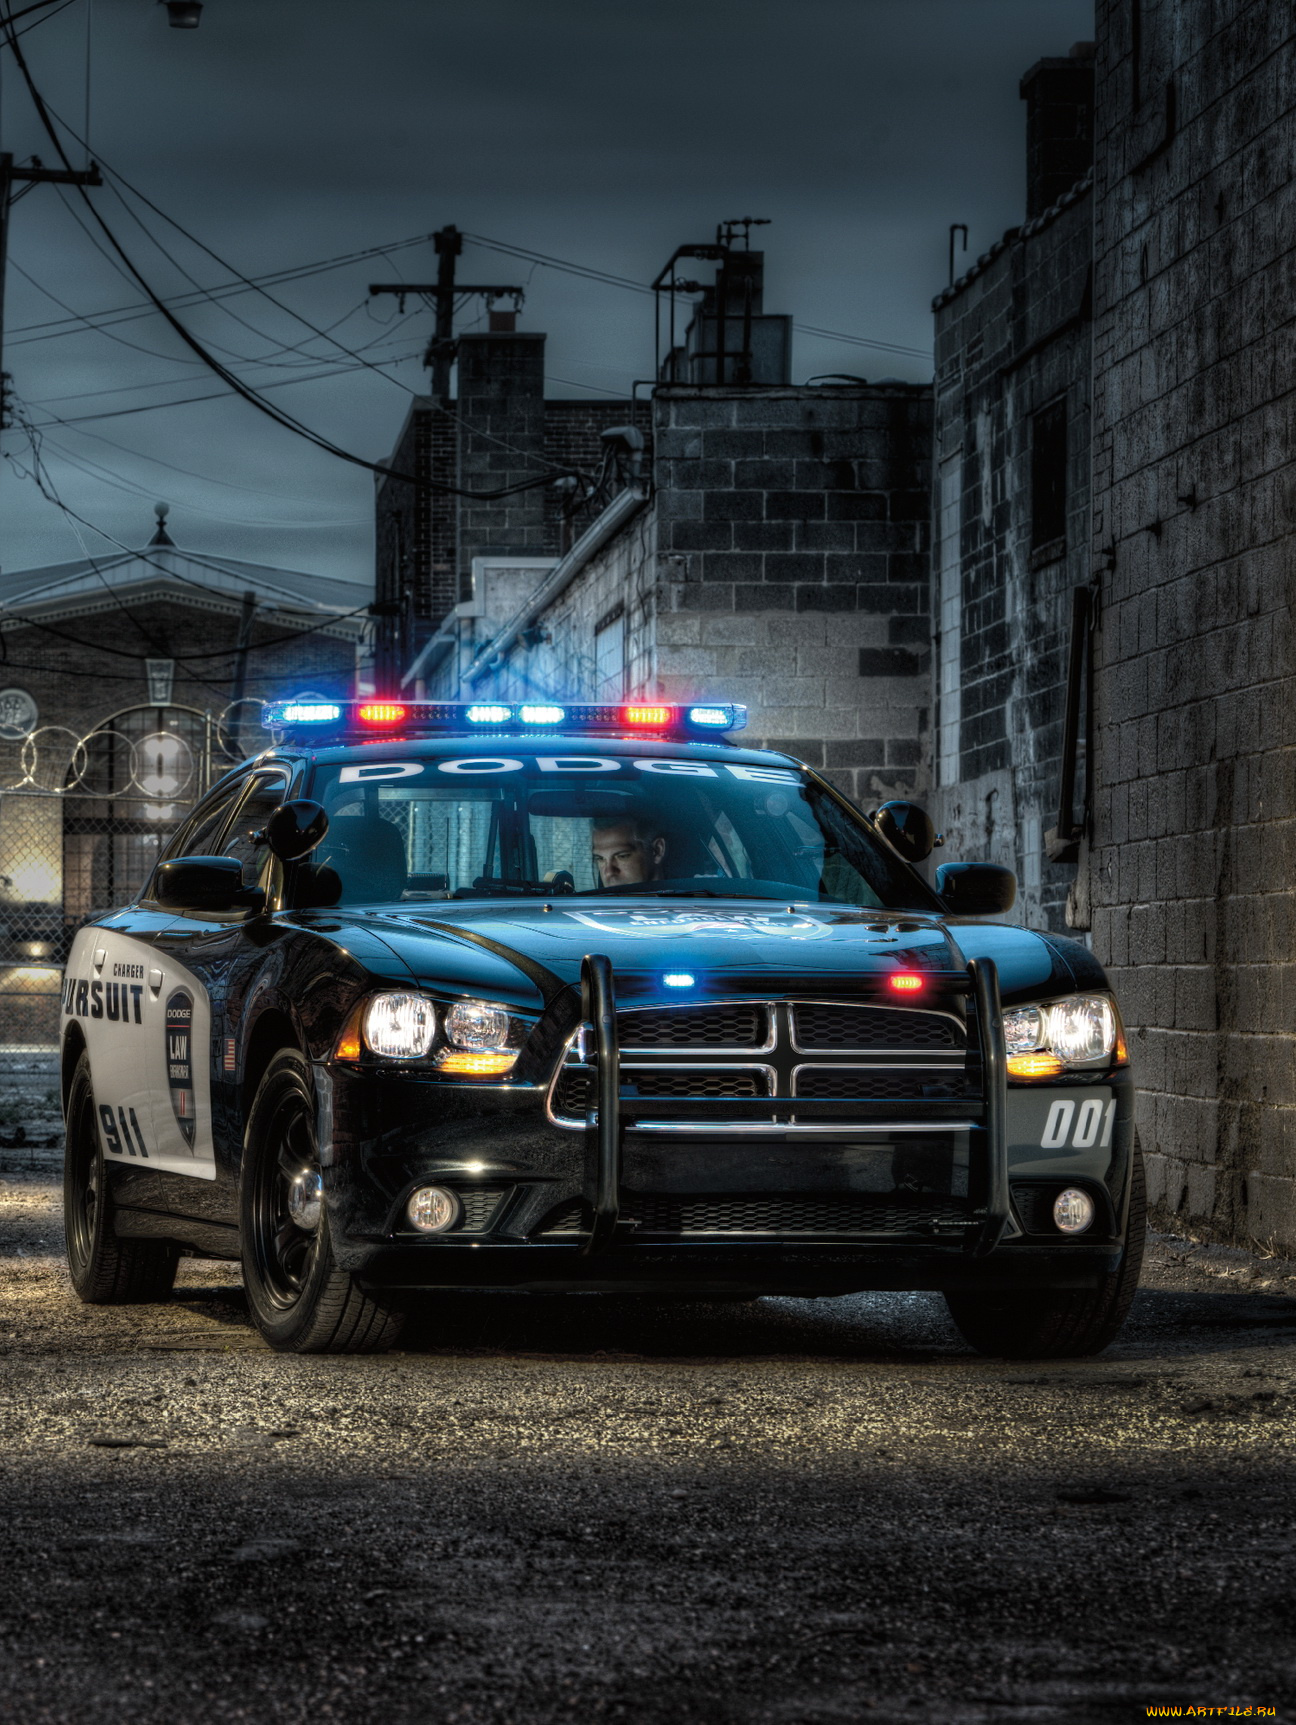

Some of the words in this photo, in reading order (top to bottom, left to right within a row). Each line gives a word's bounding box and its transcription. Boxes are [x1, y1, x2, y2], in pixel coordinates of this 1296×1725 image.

[338, 756, 803, 788] DODGE
[113, 963, 144, 979] CHARGER
[167, 1009, 191, 1018] DODGE
[169, 1035, 187, 1060] LAW
[99, 1104, 149, 1158] 911
[1040, 1099, 1117, 1148] 001
